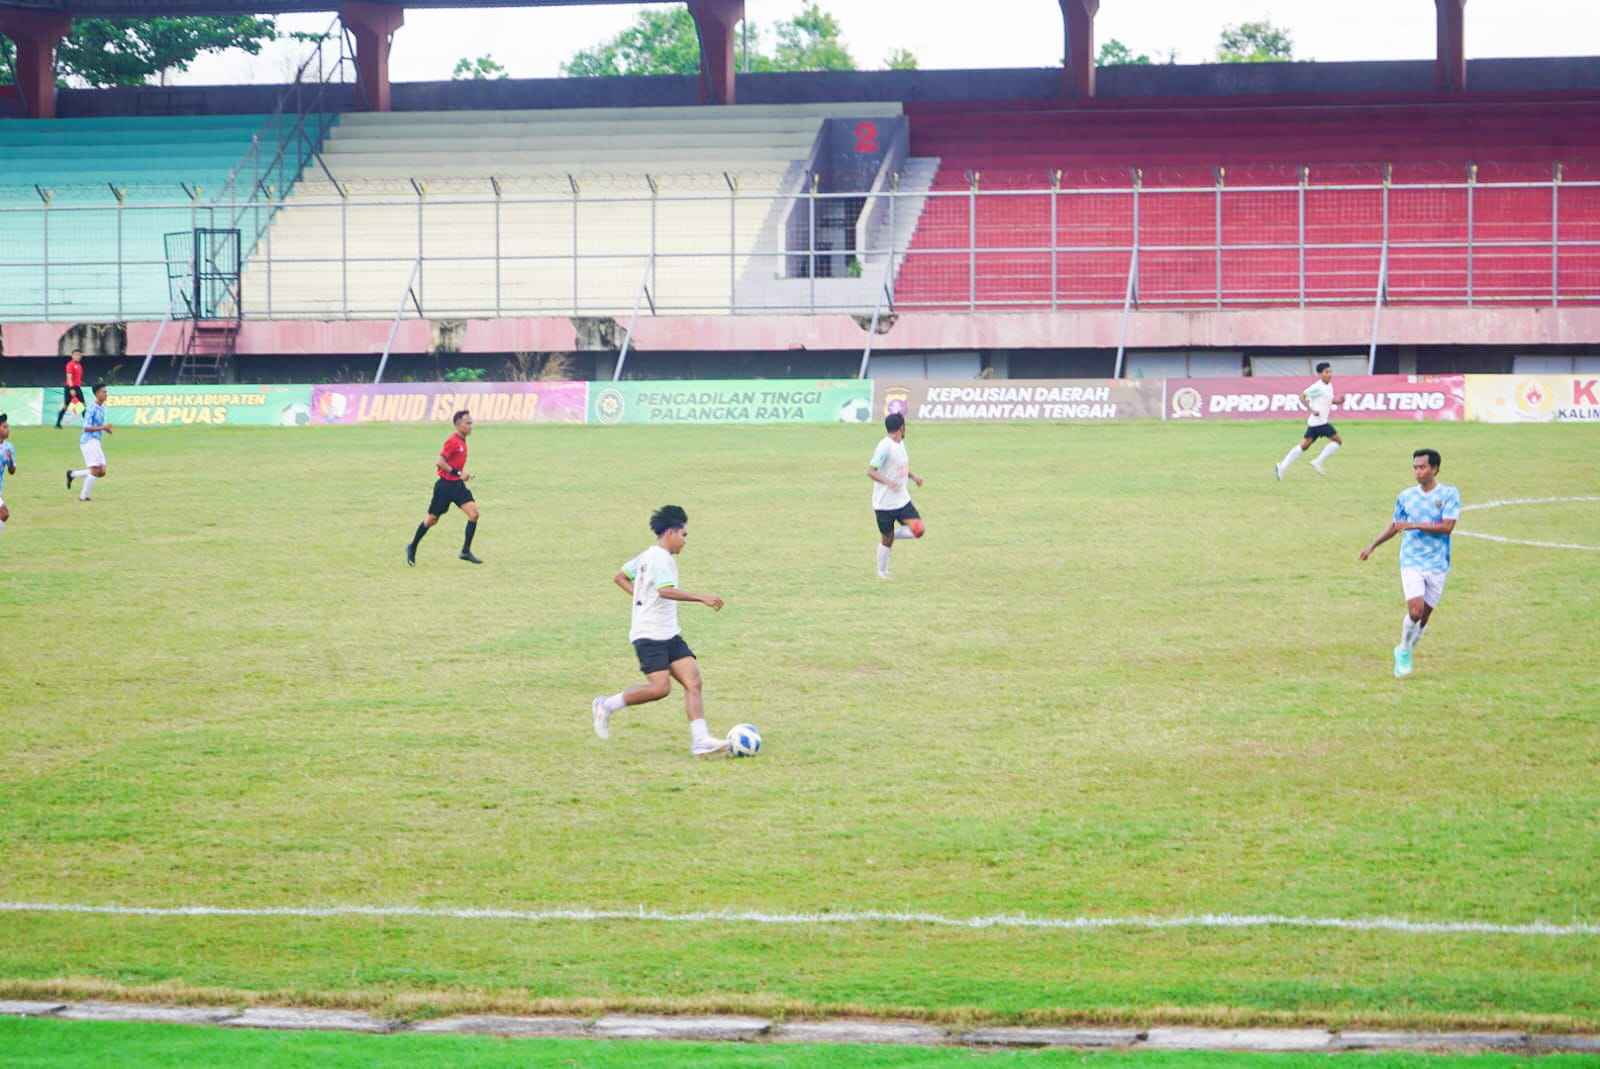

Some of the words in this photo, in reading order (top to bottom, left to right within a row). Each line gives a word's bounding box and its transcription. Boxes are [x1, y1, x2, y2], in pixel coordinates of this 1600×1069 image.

[855, 121, 879, 153] 2
[106, 395, 184, 406] EMERINTAH
[183, 393, 266, 405] KABUPATEN
[636, 392, 753, 406] PENGADILAN
[760, 391, 822, 405] TINGGI
[927, 387, 1032, 402] KEPOLISIAN
[1033, 387, 1110, 401] DAERAH
[1573, 379, 1600, 405] K
[358, 394, 427, 421] LANUD
[431, 393, 538, 421] ISKANDAR
[1209, 393, 1271, 412] DPRD
[1343, 392, 1444, 410] KALTENG
[135, 407, 226, 424] KAPUAS
[650, 407, 751, 421] PALANGKA
[754, 407, 805, 420] RAYA
[918, 404, 1039, 418] KALIMANTAN
[1043, 404, 1117, 418] TENGAH
